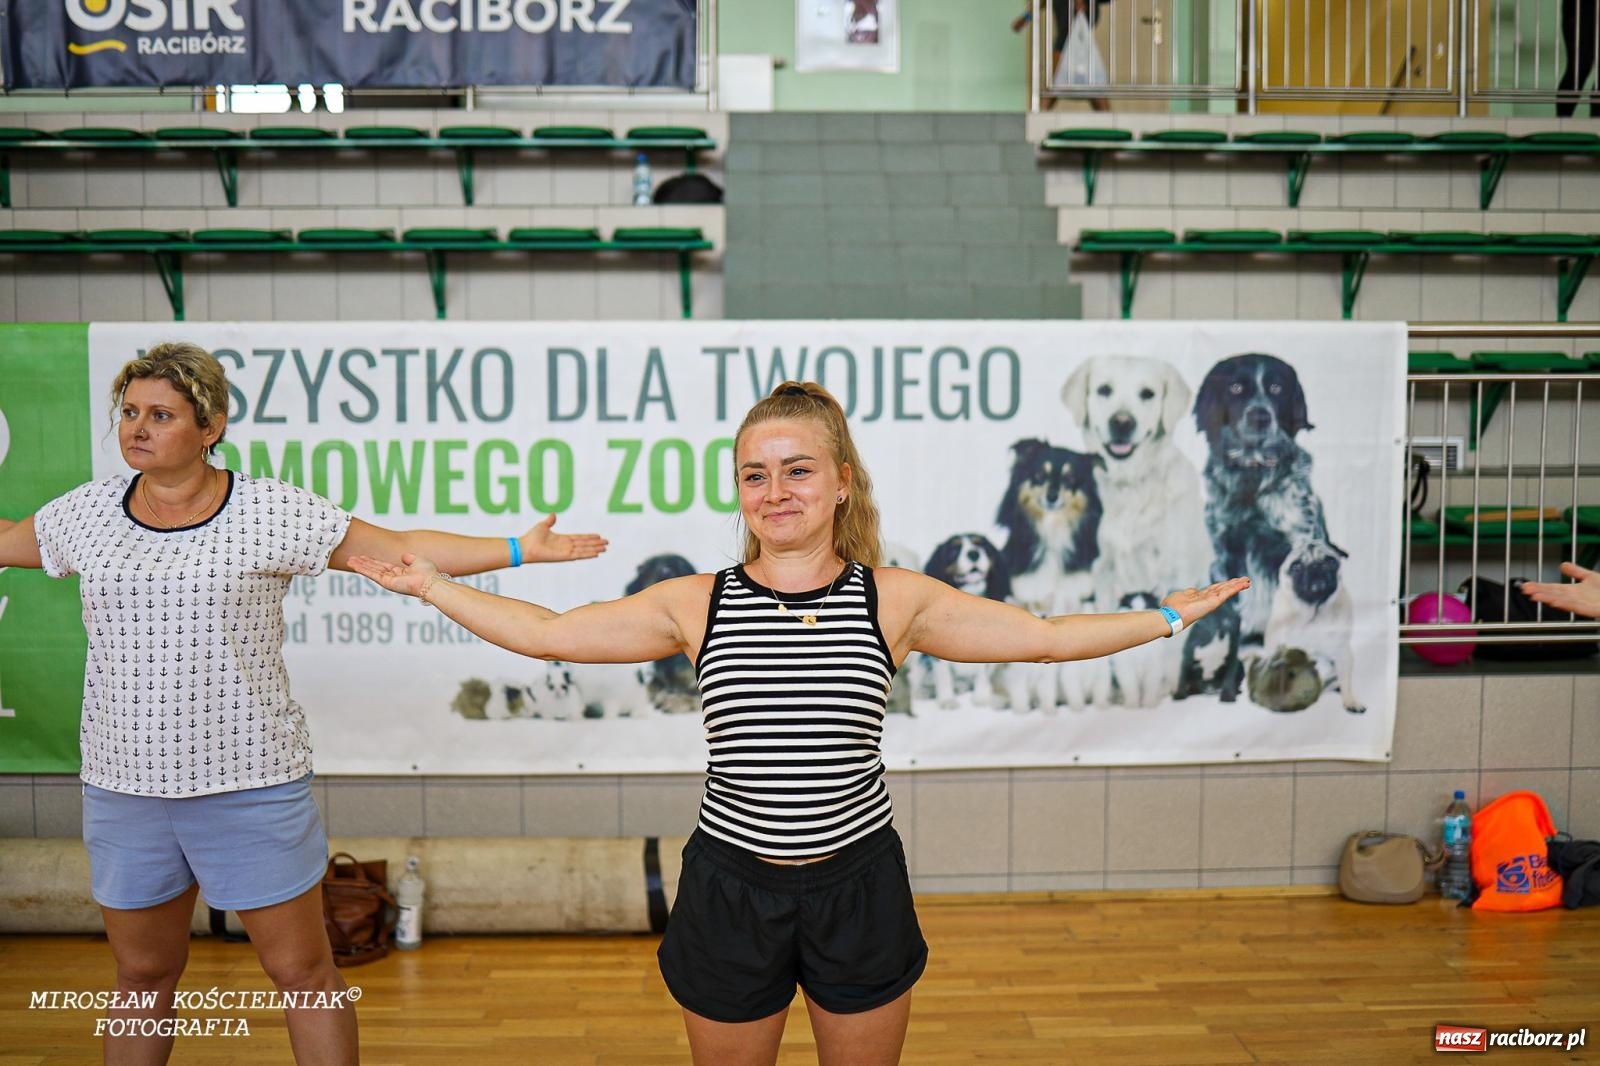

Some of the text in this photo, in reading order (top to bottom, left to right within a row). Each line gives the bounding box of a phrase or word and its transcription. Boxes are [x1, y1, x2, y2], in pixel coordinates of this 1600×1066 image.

[137, 32, 246, 55] RACIBÓRZ
[136, 346, 1021, 424] SZYSTKO DLA TWOJEGO
[607, 438, 738, 514] ZOO
[321, 613, 394, 644] 1989
